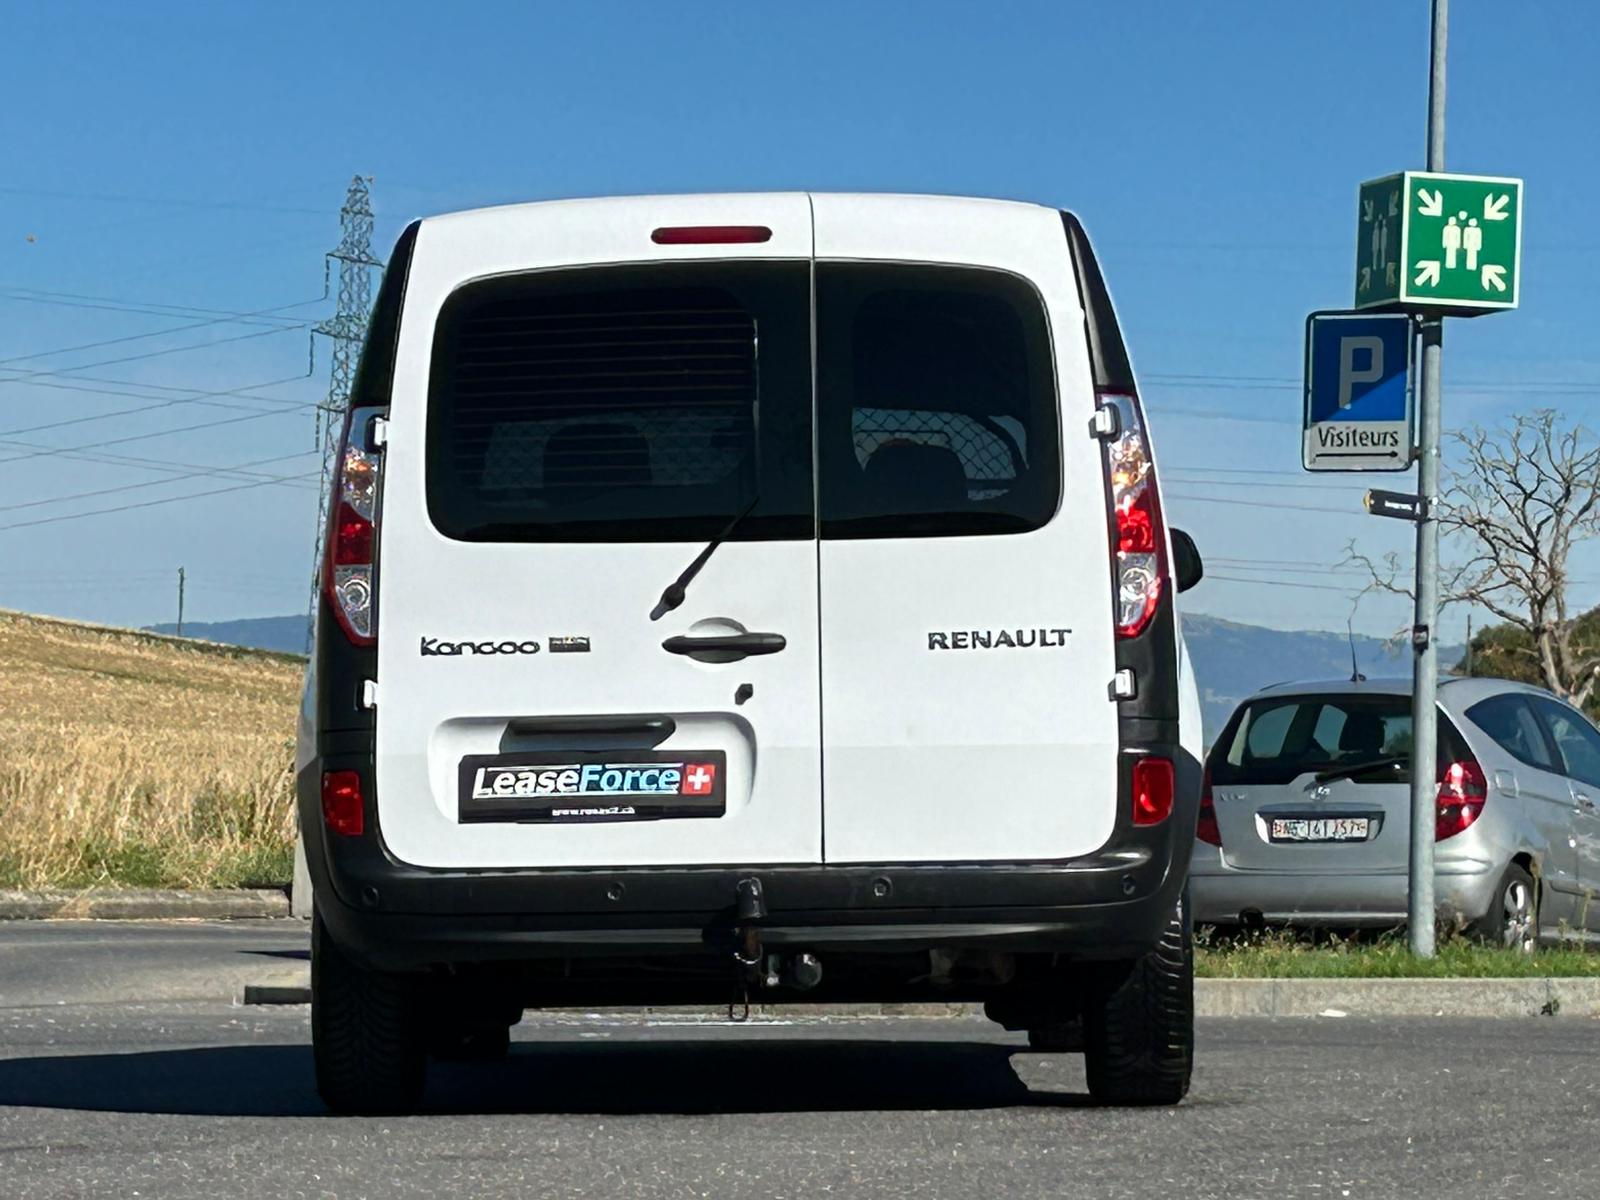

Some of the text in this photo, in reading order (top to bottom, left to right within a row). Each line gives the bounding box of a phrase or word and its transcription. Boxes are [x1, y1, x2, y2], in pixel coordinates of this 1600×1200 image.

[1339, 336, 1384, 409] P
[1318, 426, 1399, 448] Visiteurs
[928, 629, 1072, 650] RENAULT
[473, 763, 681, 799] LeaseForce
